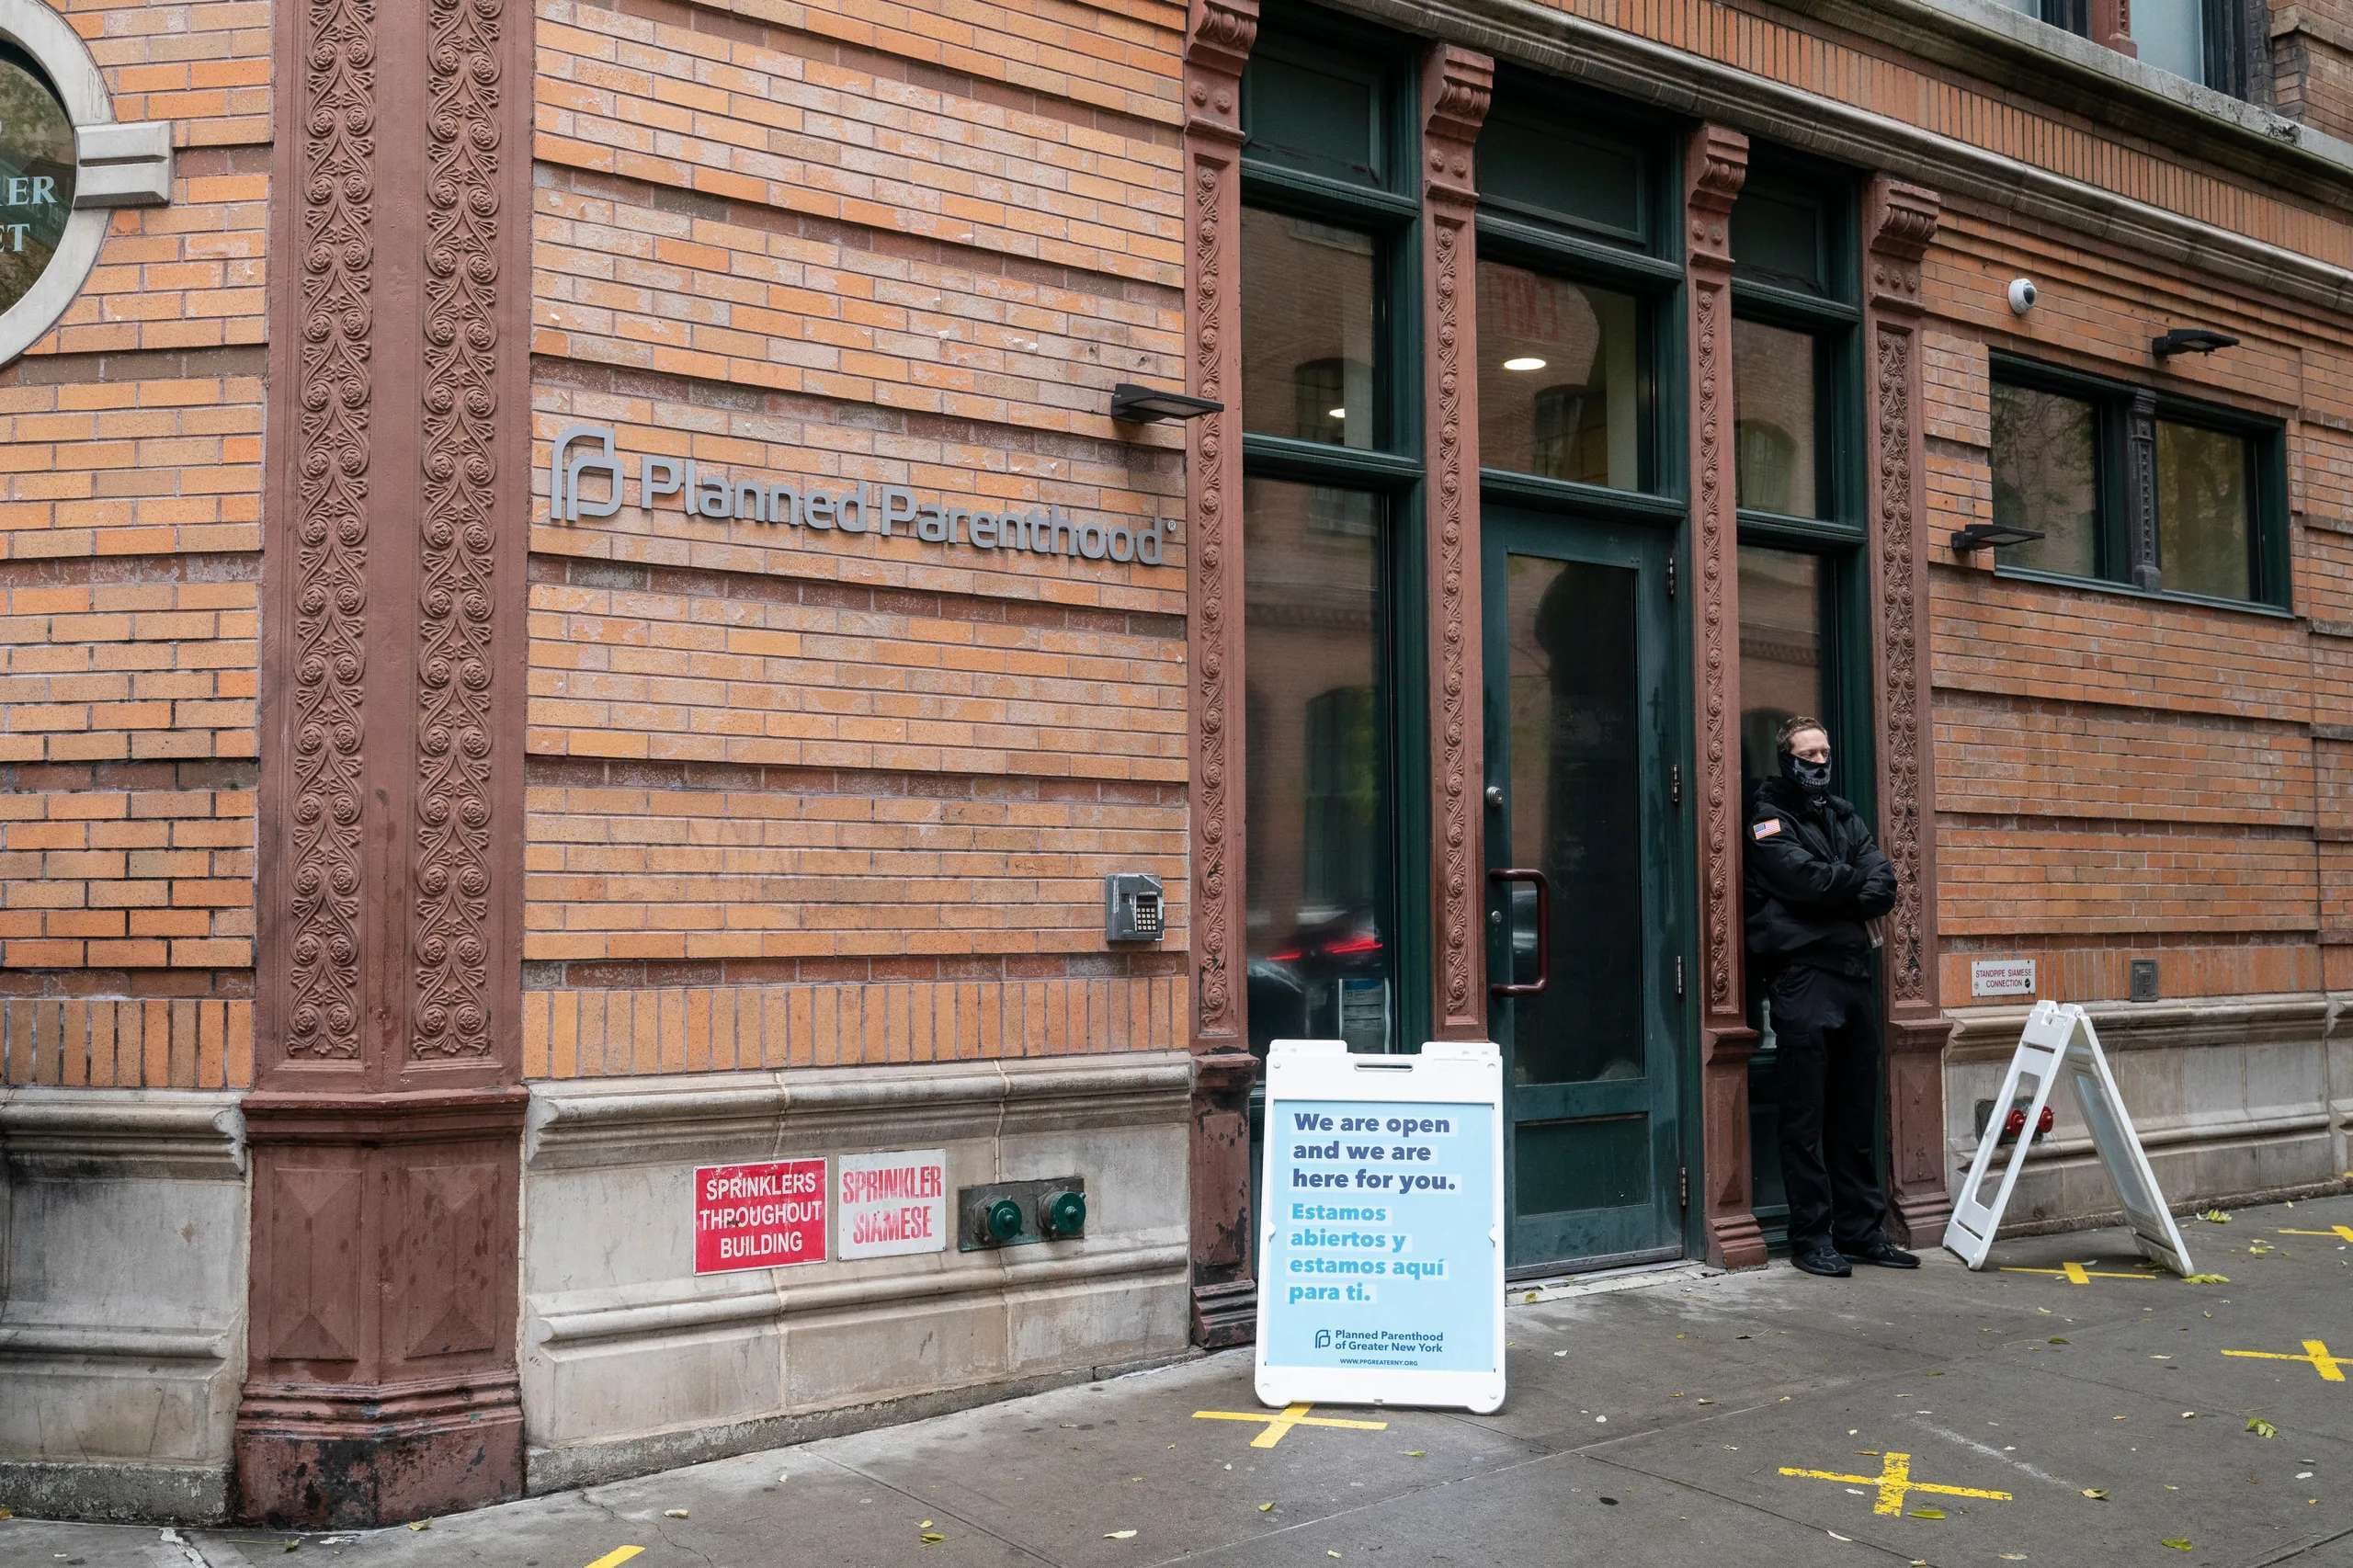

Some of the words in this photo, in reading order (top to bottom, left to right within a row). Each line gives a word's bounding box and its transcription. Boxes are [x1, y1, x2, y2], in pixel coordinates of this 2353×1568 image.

[0, 176, 58, 207] ER
[0, 223, 30, 253] T
[641, 458, 869, 533] Planned
[1975, 970, 2006, 979] STANDPIPE
[2007, 968, 2032, 978] SIAMESE
[1985, 979, 2023, 988] CONNECTION
[1294, 1113, 1334, 1131] We
[1340, 1115, 1380, 1131] are
[1386, 1118, 1450, 1137] open
[1293, 1141, 1340, 1159] and
[1347, 1145, 1385, 1160] we
[1392, 1145, 1431, 1161] are
[706, 1172, 817, 1201] SPRINKLERS
[842, 1165, 943, 1205] SPRINKLER
[1292, 1168, 1349, 1187] here
[1355, 1168, 1393, 1188] for
[1399, 1175, 1456, 1194] you.
[699, 1200, 823, 1232] THROUGHOUT
[1291, 1203, 1387, 1221] Estamos
[853, 1205, 933, 1244] SIAMESE
[720, 1231, 802, 1259] BUILDING
[1290, 1228, 1386, 1248] abiertos
[1392, 1234, 1407, 1253] y
[1290, 1256, 1386, 1276] estamos
[1392, 1258, 1445, 1280] aquí
[1289, 1286, 1340, 1304] para
[1346, 1282, 1371, 1301] ti.
[1335, 1340, 1346, 1350] of
[1348, 1341, 1389, 1351] Greater
[1392, 1343, 1416, 1352] New
[1418, 1343, 1443, 1353] York
[1336, 1329, 1379, 1340] Planned
[1381, 1331, 1444, 1342] Parenthood
[1340, 1358, 1418, 1367] WWW.PPGREATERNY.ORG
